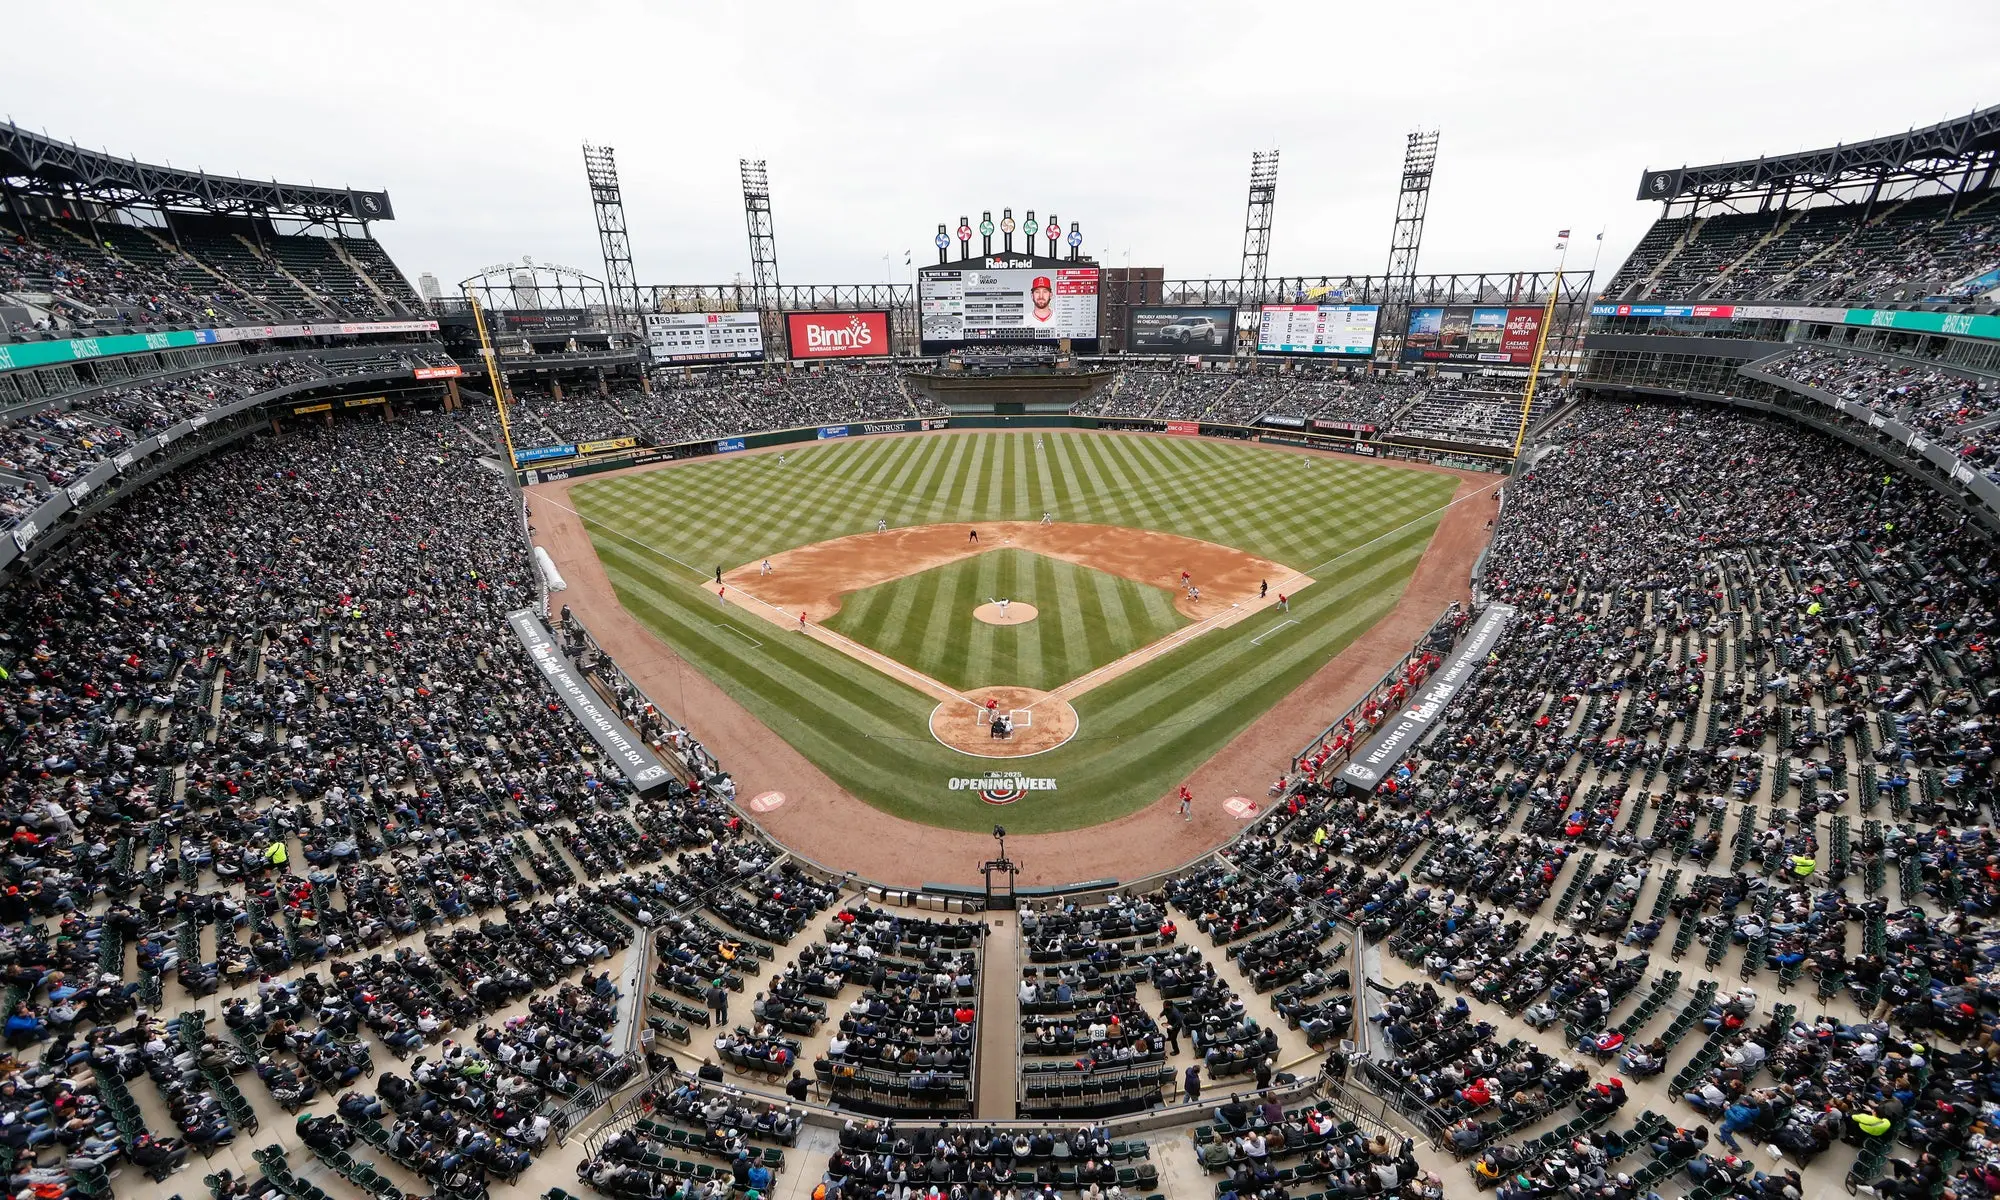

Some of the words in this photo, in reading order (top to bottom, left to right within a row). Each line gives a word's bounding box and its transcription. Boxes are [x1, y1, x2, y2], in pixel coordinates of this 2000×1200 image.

[480, 262, 517, 278] KIDS
[544, 262, 584, 280] ZONE
[986, 258, 1008, 268] Rate
[1010, 260, 1032, 268] Field
[968, 272, 979, 286] 3
[1876, 312, 1896, 326] RUSH
[1949, 316, 1974, 334] RUSH
[76, 339, 101, 358] RUSH
[150, 334, 170, 347] RUSH
[864, 424, 905, 432] WINTRUST
[1356, 442, 1374, 453] Rate
[547, 473, 568, 481] Modelo
[519, 618, 538, 639] WELCOME
[530, 642, 552, 661] Rate
[1443, 667, 1459, 682] HOME
[1455, 659, 1465, 668] OF
[1463, 649, 1474, 662] THE
[1470, 631, 1487, 653] CHICAGO
[1482, 620, 1495, 636] WHITE
[539, 654, 564, 674] Field
[1404, 702, 1439, 723] Rate
[1424, 682, 1455, 704] Field
[558, 672, 574, 690] HOME
[570, 686, 580, 697] OF
[578, 694, 590, 707] THE
[584, 705, 611, 730] CHICAGO
[606, 728, 631, 751] WHITE
[624, 749, 645, 766] SOX
[1366, 733, 1405, 764] WELCOME
[1400, 721, 1413, 734] TO
[948, 777, 1014, 790] OPENING
[1015, 777, 1057, 790] WEEK
[1892, 985, 1908, 996] 88
